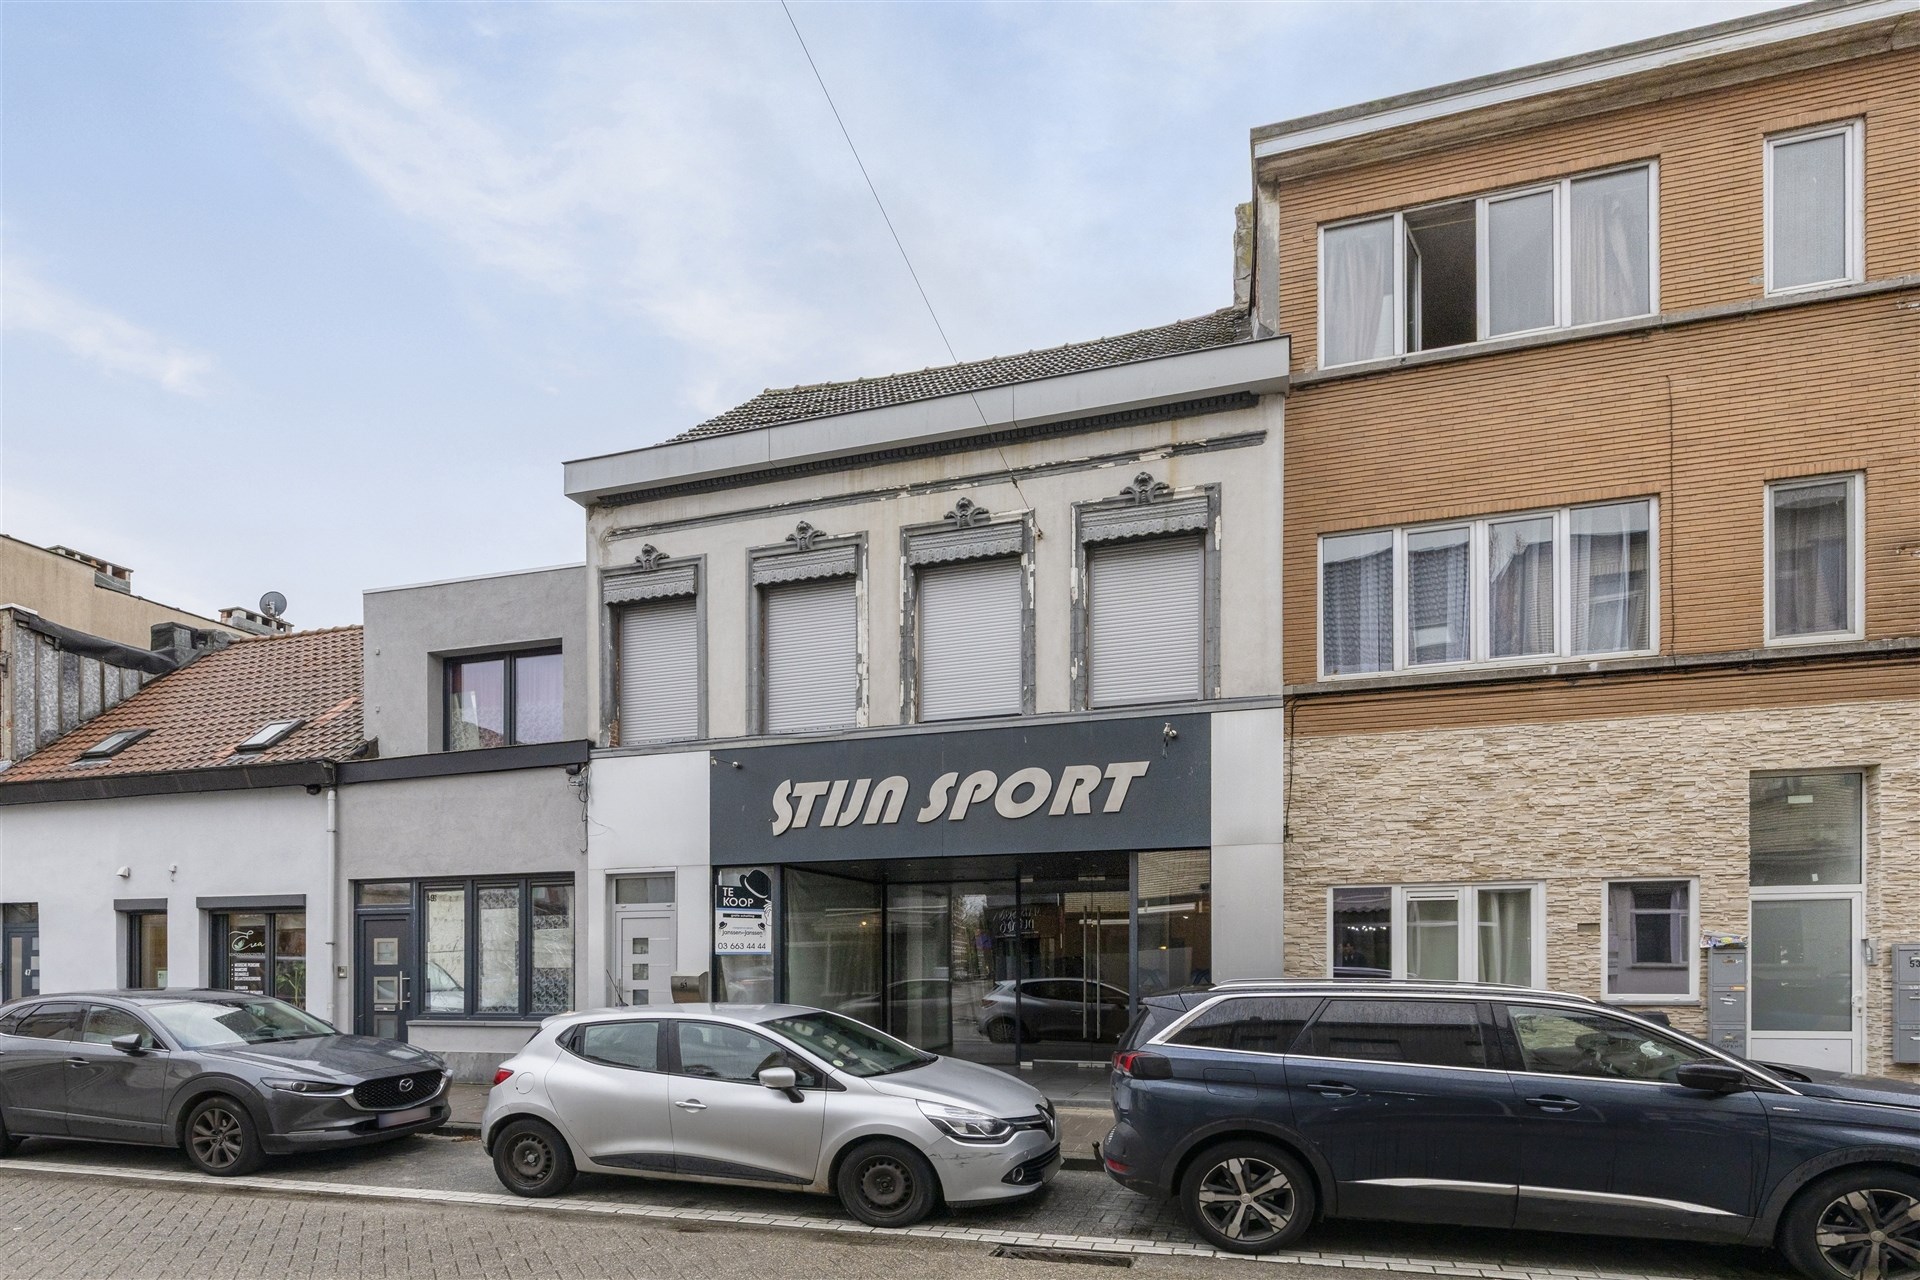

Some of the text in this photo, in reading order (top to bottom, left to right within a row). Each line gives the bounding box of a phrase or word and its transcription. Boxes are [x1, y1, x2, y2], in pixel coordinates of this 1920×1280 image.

[916, 761, 1151, 823] SPORT
[722, 887, 734, 897] TE
[723, 897, 754, 907] KOOP
[718, 942, 766, 950] 03 663 44 44
